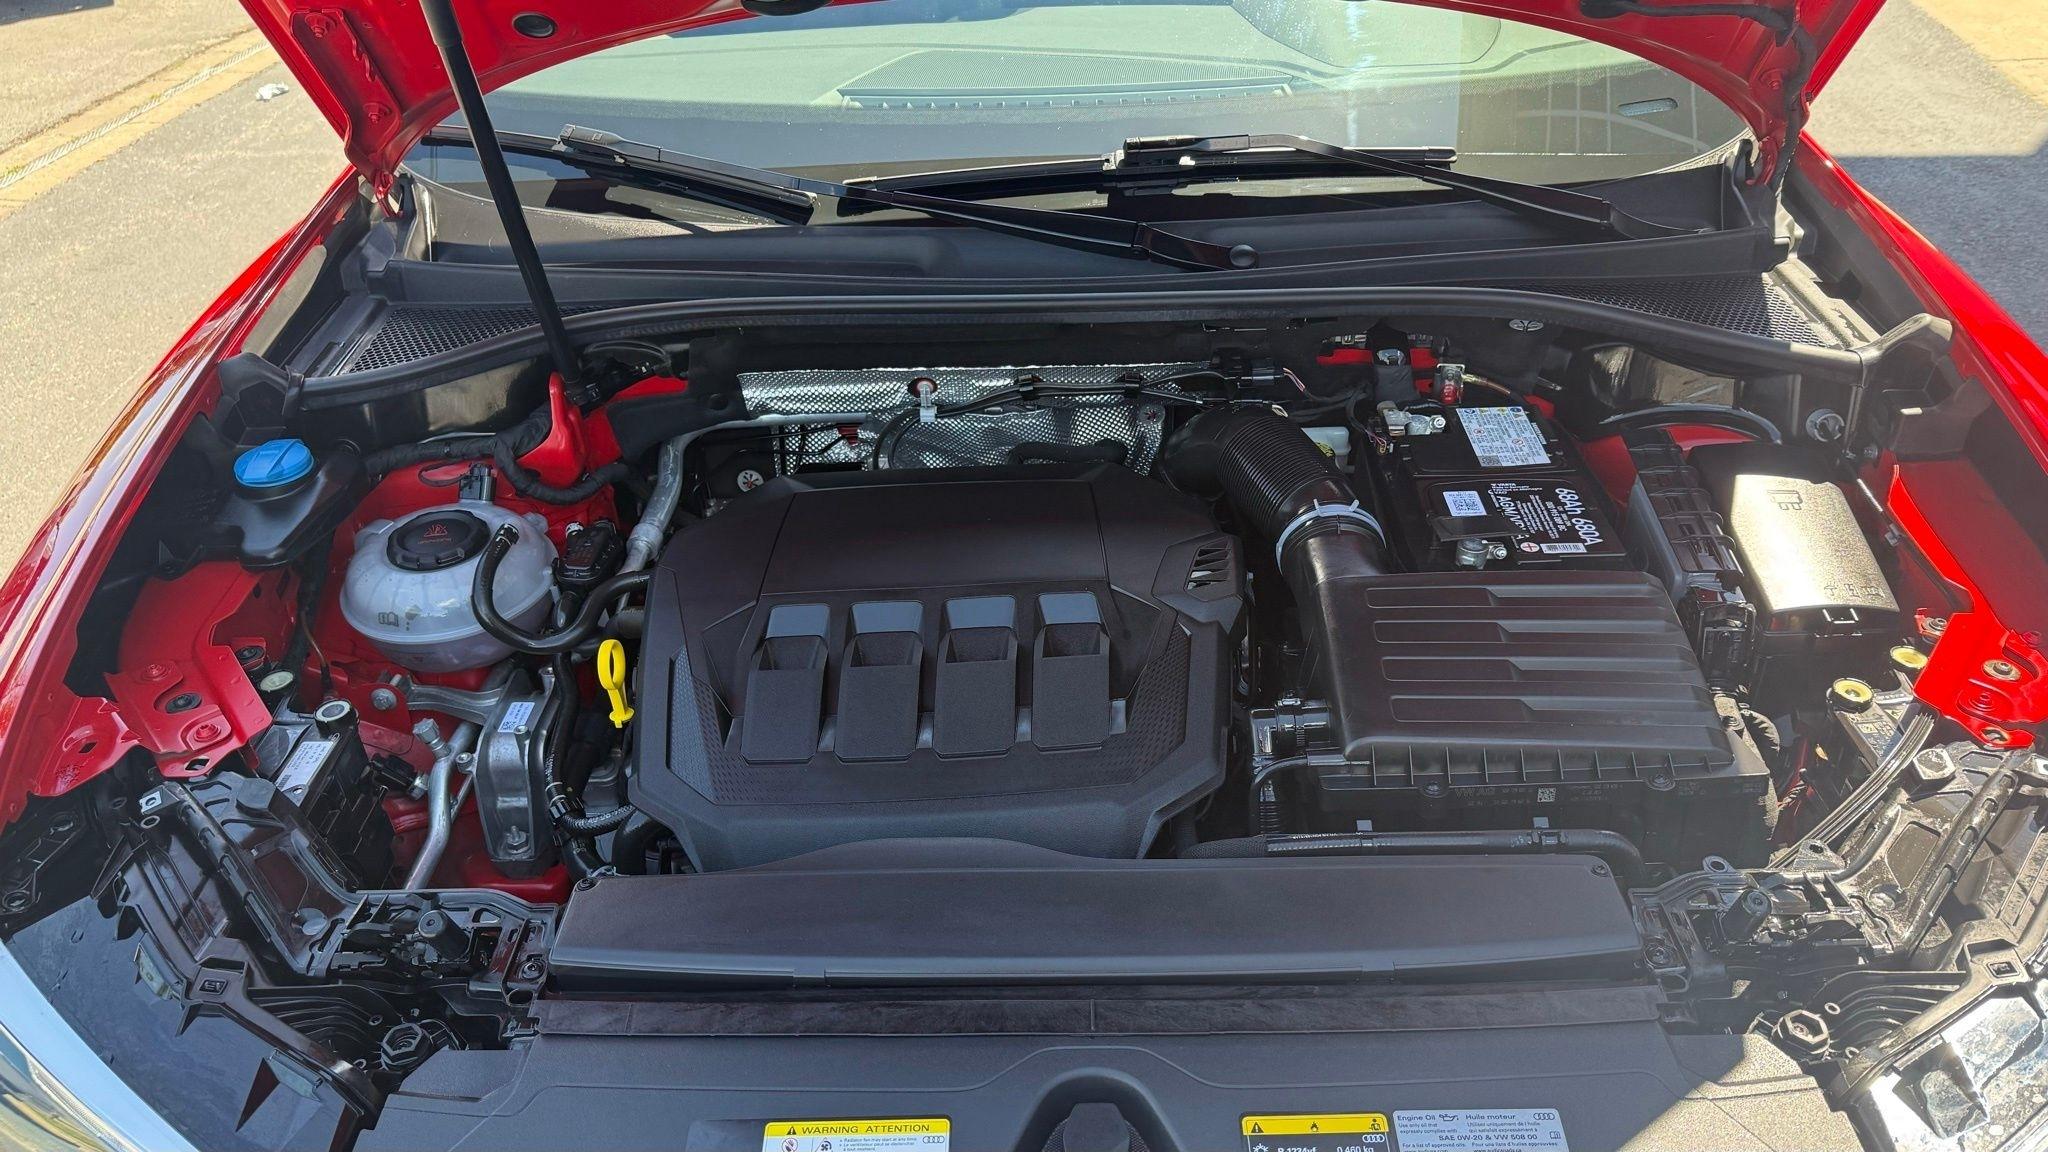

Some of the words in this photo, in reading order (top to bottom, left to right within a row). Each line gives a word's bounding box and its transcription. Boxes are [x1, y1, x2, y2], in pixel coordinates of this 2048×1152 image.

[1496, 495, 1531, 540] AGM/VR
[1555, 488, 1585, 515] 68Ah
[1571, 517, 1604, 546] 680A
[1397, 1114, 1423, 1122] Engine
[1465, 1113, 1485, 1121] Huile
[1487, 1113, 1516, 1121] moteur
[801, 1126, 859, 1135] WARNING
[865, 1124, 930, 1133] ATTENTION
[1494, 1133, 1509, 1141] VW
